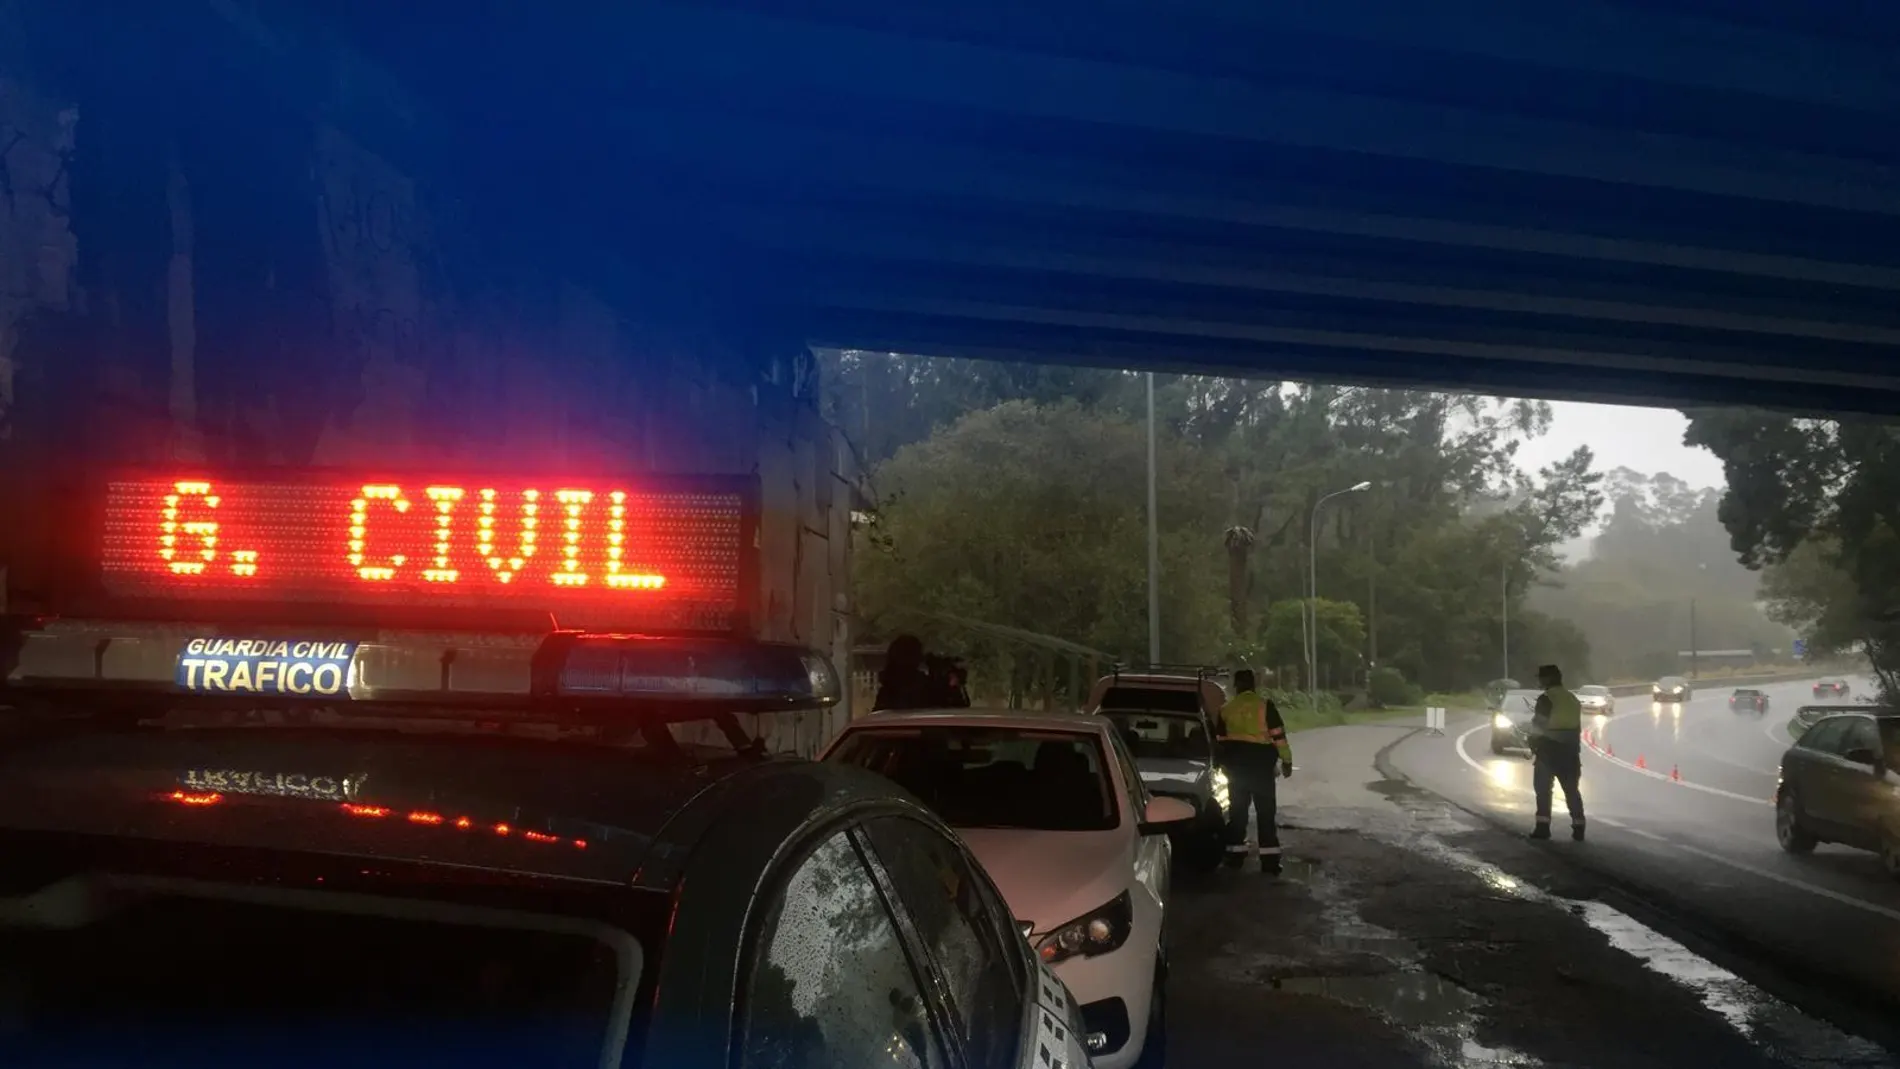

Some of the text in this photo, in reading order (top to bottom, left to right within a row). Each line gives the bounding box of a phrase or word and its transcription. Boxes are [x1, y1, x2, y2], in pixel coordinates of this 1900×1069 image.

[159, 481, 666, 588] G. CIVIL
[187, 638, 350, 659] GUARDIA CIVIL
[182, 658, 342, 695] TRAFICO
